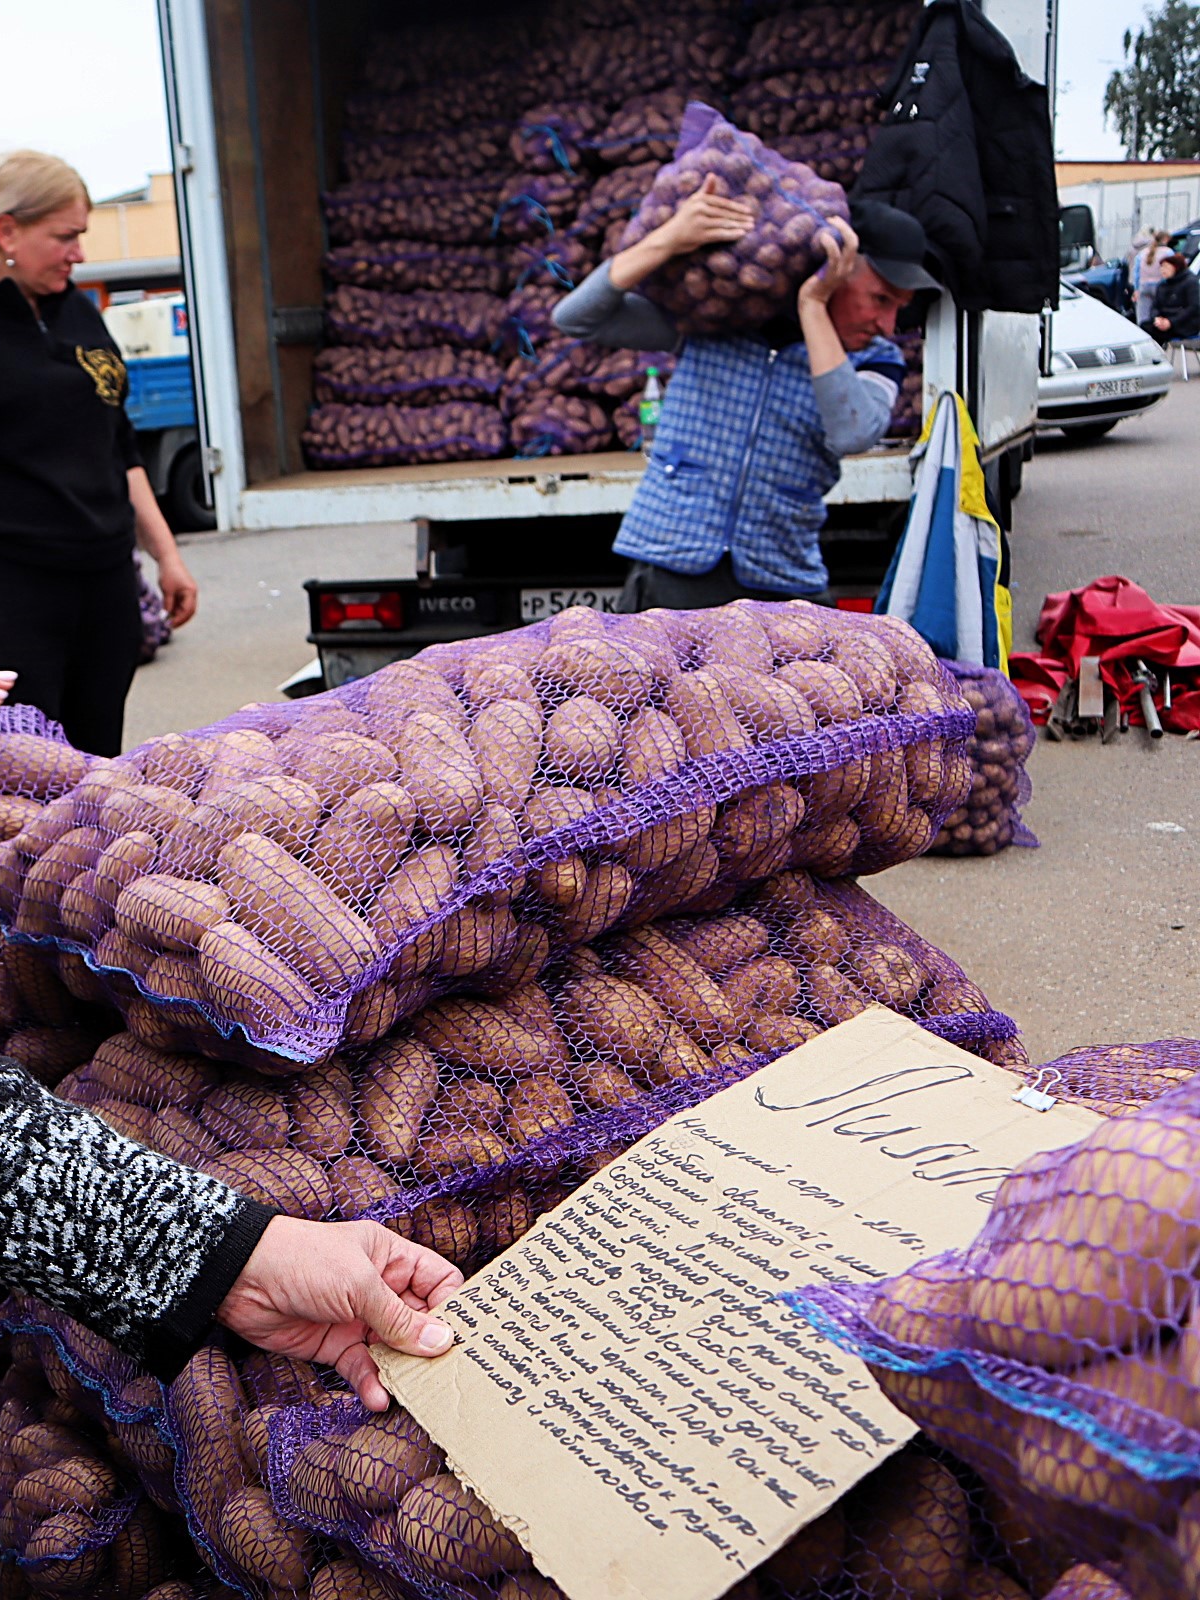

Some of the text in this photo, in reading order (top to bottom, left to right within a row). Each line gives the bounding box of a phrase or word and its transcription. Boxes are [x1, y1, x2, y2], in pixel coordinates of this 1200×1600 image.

[418, 596, 476, 612] IVECO
[607, 1164, 700, 1229] Содержание
[643, 1136, 715, 1184] Клубень
[721, 1186, 828, 1241] овальный
[814, 1242, 834, 1251] с
[786, 1178, 845, 1208] сорт
[711, 1201, 784, 1247] Кожура
[788, 1249, 810, 1259] и
[564, 1266, 606, 1287] для
[619, 1232, 709, 1286] умеренно
[846, 1379, 869, 1391] и
[701, 1313, 749, 1338] для
[684, 1325, 776, 1391] Особенно
[525, 1403, 543, 1417] и
[579, 1331, 597, 1341] и
[666, 1402, 725, 1447] Пюре
